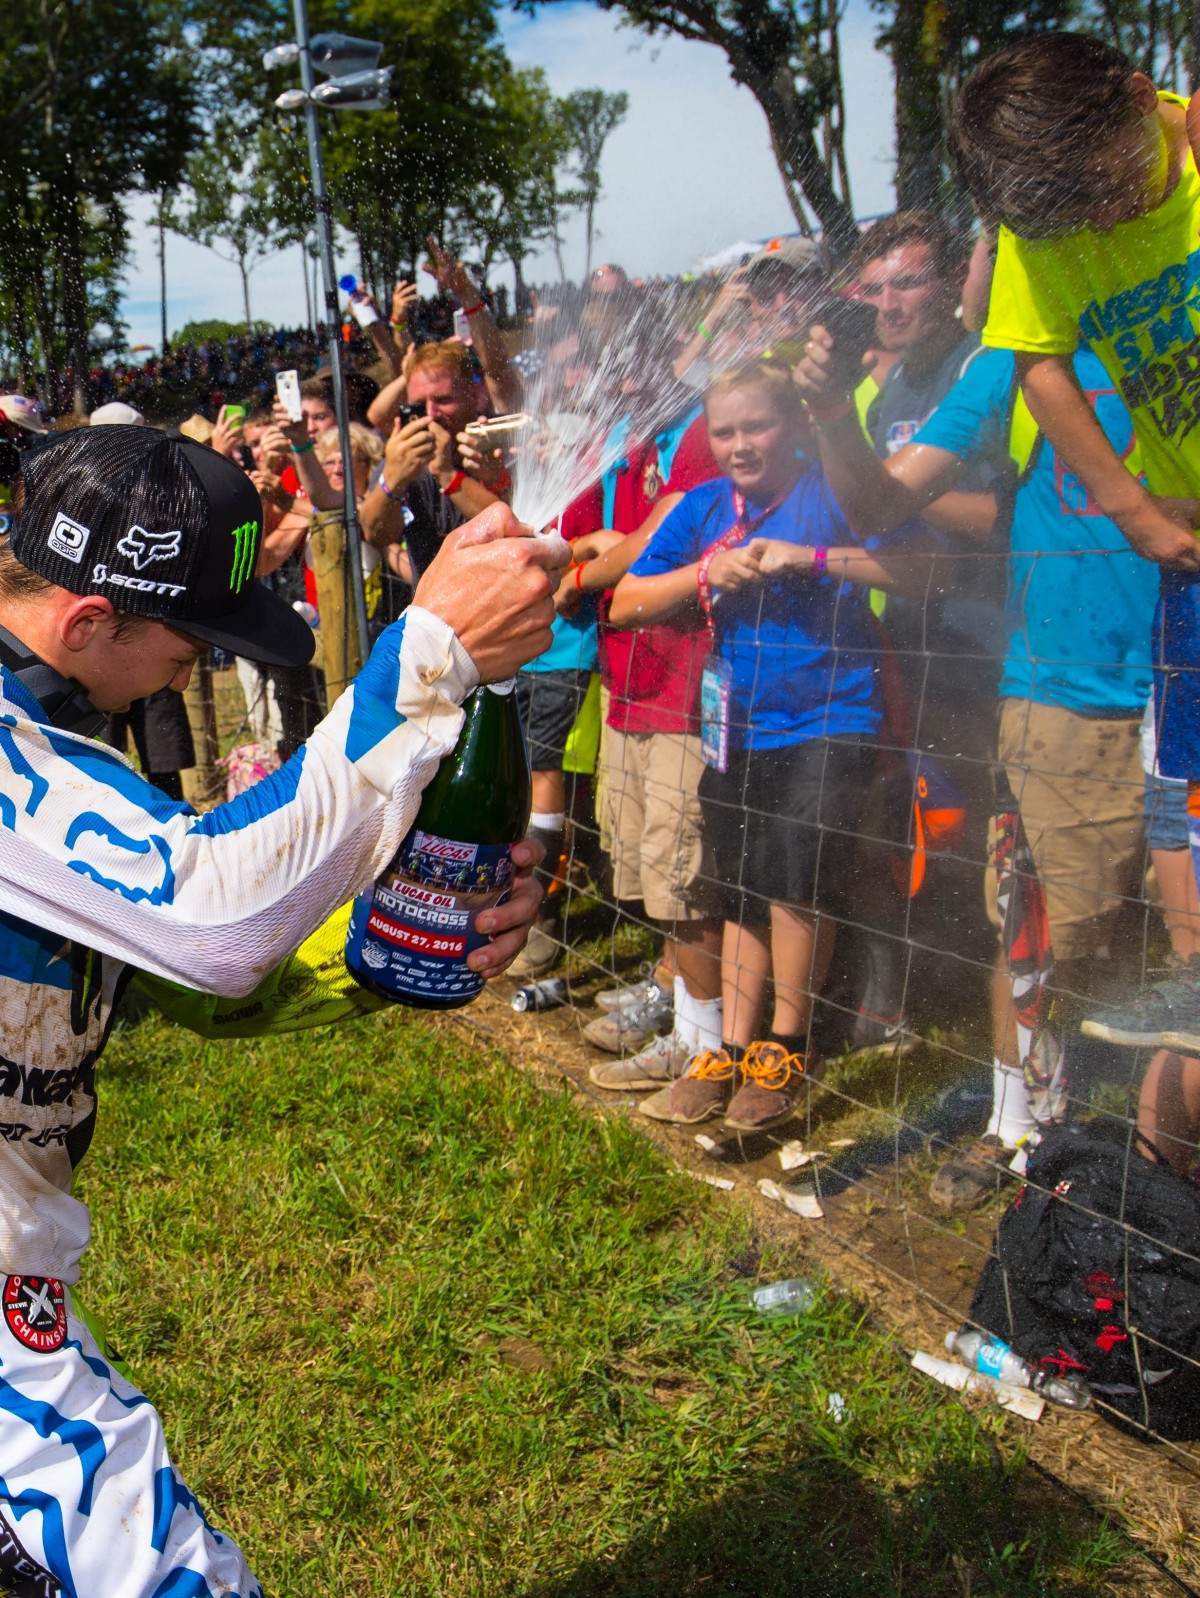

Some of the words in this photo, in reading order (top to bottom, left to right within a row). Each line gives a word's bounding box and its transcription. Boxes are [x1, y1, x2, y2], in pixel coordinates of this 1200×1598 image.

[52, 538, 78, 558] OGIO
[107, 573, 187, 597] SCOTT
[420, 840, 474, 860] LUCAS
[374, 888, 470, 927] MOTOCROSS
[394, 882, 433, 904] LUCAS
[433, 894, 455, 908] OIL
[369, 916, 411, 942] AUGUST
[410, 934, 431, 949] 27,
[432, 940, 463, 952] 2016
[212, 1001, 264, 1025] SHOWA
[13, 1309, 66, 1347] CHAINSAW
